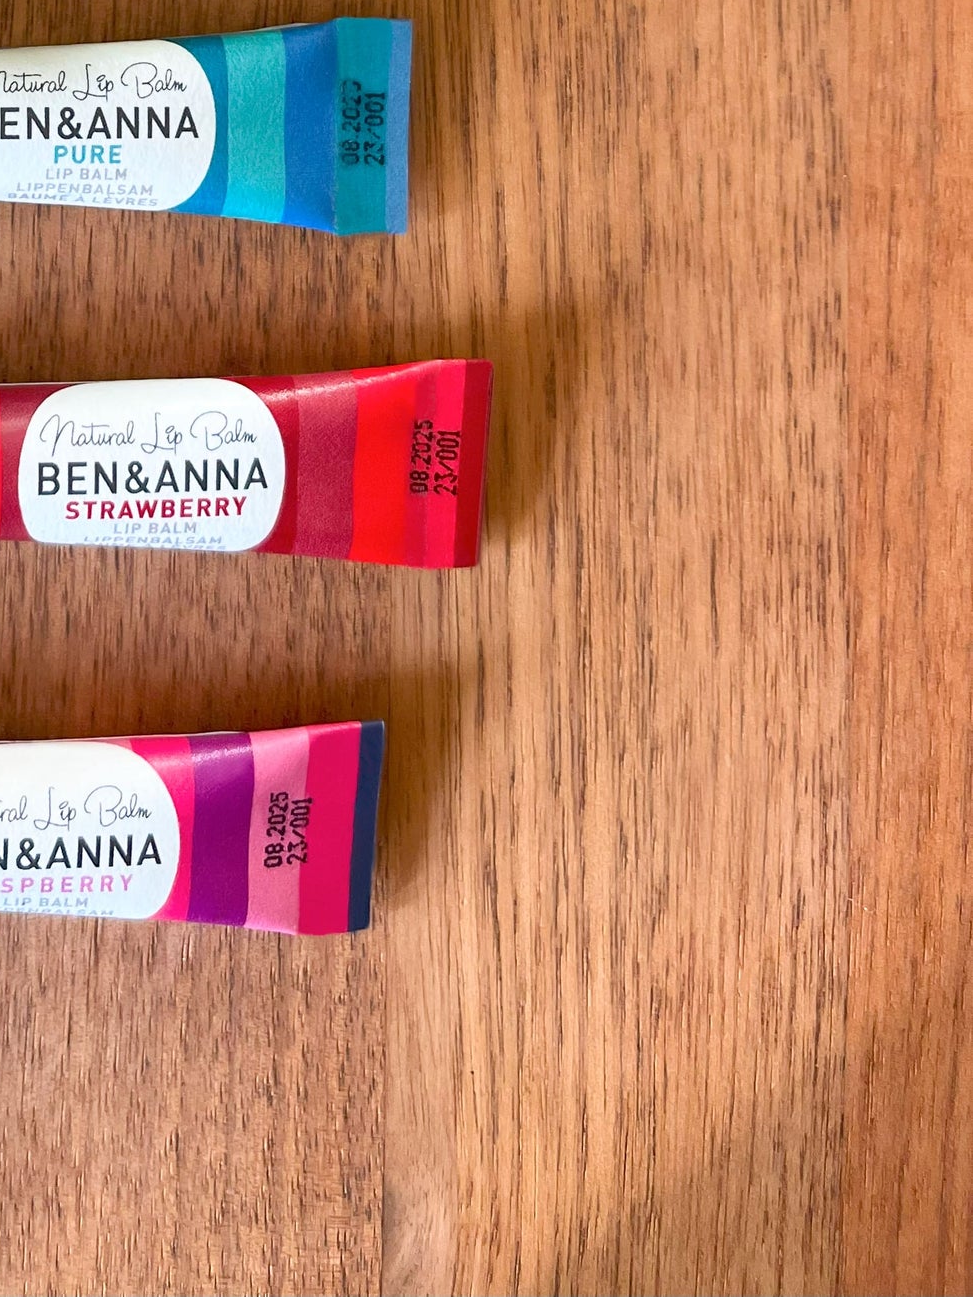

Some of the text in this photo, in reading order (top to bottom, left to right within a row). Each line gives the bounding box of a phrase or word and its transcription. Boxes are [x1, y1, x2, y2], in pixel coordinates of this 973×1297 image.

[72, 63, 114, 102] Lip
[120, 61, 188, 99] Balm
[363, 91, 386, 166] 23/001
[45, 168, 127, 181] LIP BALM
[53, 145, 123, 164] PURE
[16, 182, 154, 196] LIPPENBALSAM
[39, 410, 258, 457] Natural Lip Balm
[37, 457, 268, 496] BEN&ANNA
[409, 419, 434, 494] 08.2025
[433, 430, 461, 497] 23/001
[65, 496, 247, 520] STRAWBERRY
[113, 522, 197, 534] LIP BALM
[83, 535, 223, 545] LIPPENBALSAM
[33, 786, 76, 832] Lip
[84, 784, 152, 828] Balm
[263, 791, 289, 869] 08.2025
[286, 797, 313, 866] 23/001
[3, 897, 89, 908] LIP BALM
